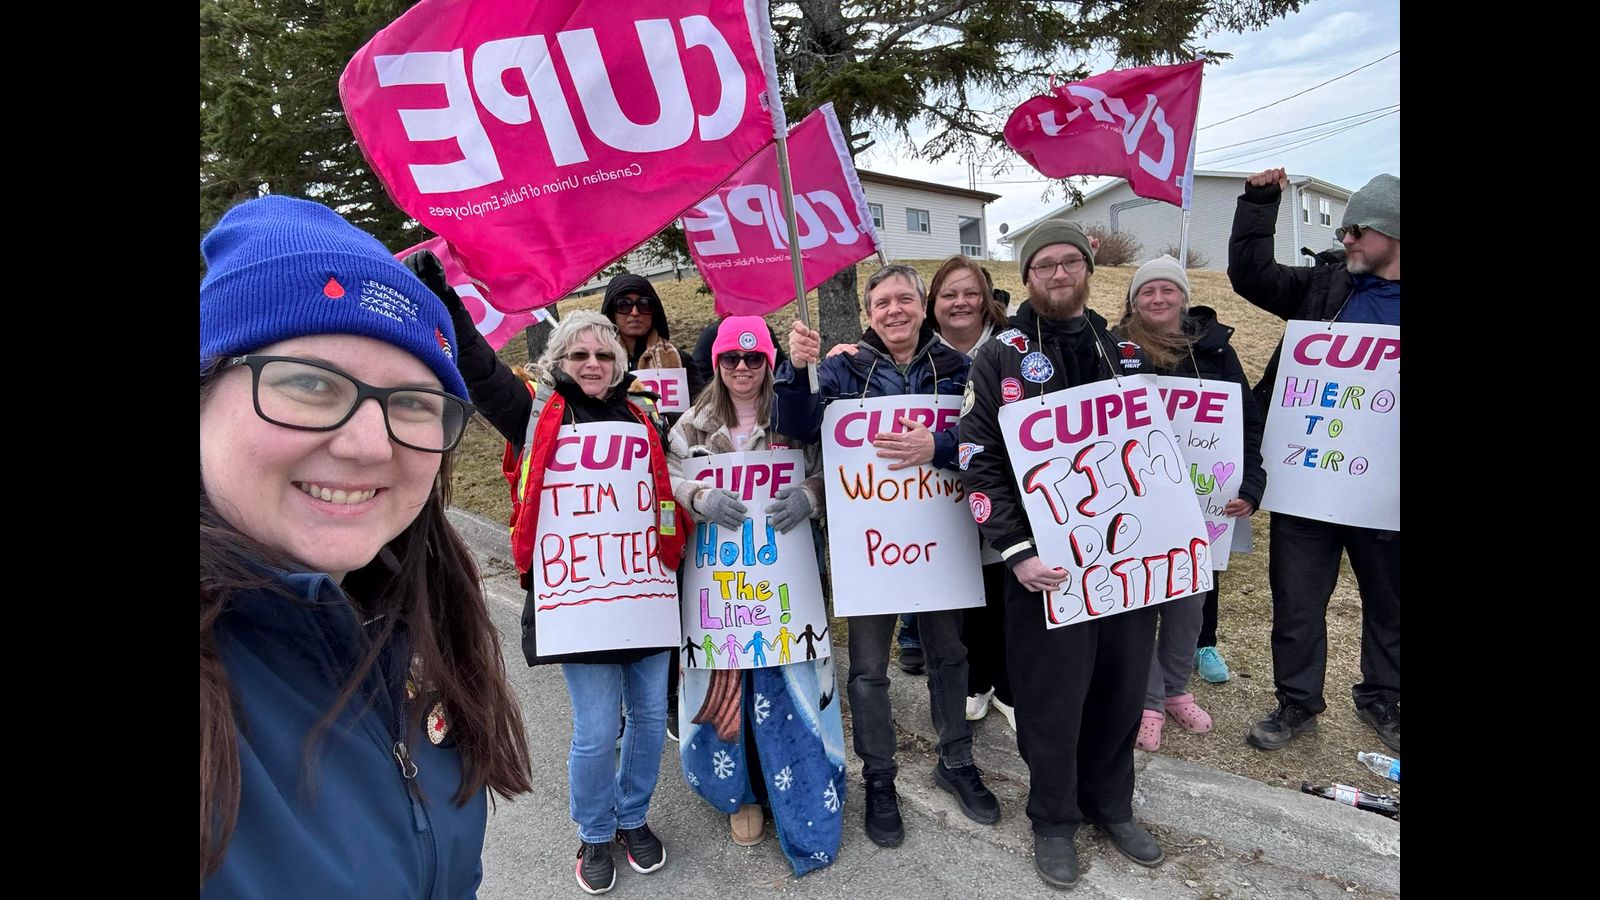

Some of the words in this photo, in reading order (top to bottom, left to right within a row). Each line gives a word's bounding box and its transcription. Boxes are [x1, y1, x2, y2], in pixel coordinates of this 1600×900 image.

[361, 279, 411, 305] LEUKEMIA
[363, 287, 418, 317] LYMPHOMA
[360, 302, 404, 323] CANADA
[1293, 333, 1400, 375] CUP
[1158, 387, 1230, 425] PE
[1281, 376, 1396, 414] HERO
[1018, 387, 1152, 452] CUPE
[1304, 414, 1344, 439] TO
[545, 434, 652, 475] CUP
[1187, 428, 1222, 451] look
[1022, 430, 1183, 526] TIM
[1283, 443, 1369, 476] ZERO
[542, 481, 620, 518] TIM
[1205, 497, 1232, 517] loo
[540, 525, 667, 589] BETTER
[695, 515, 778, 569] Hold
[864, 528, 938, 568] Poor
[1068, 512, 1143, 569] DO
[712, 571, 774, 602] The
[1046, 537, 1211, 625] BETTER
